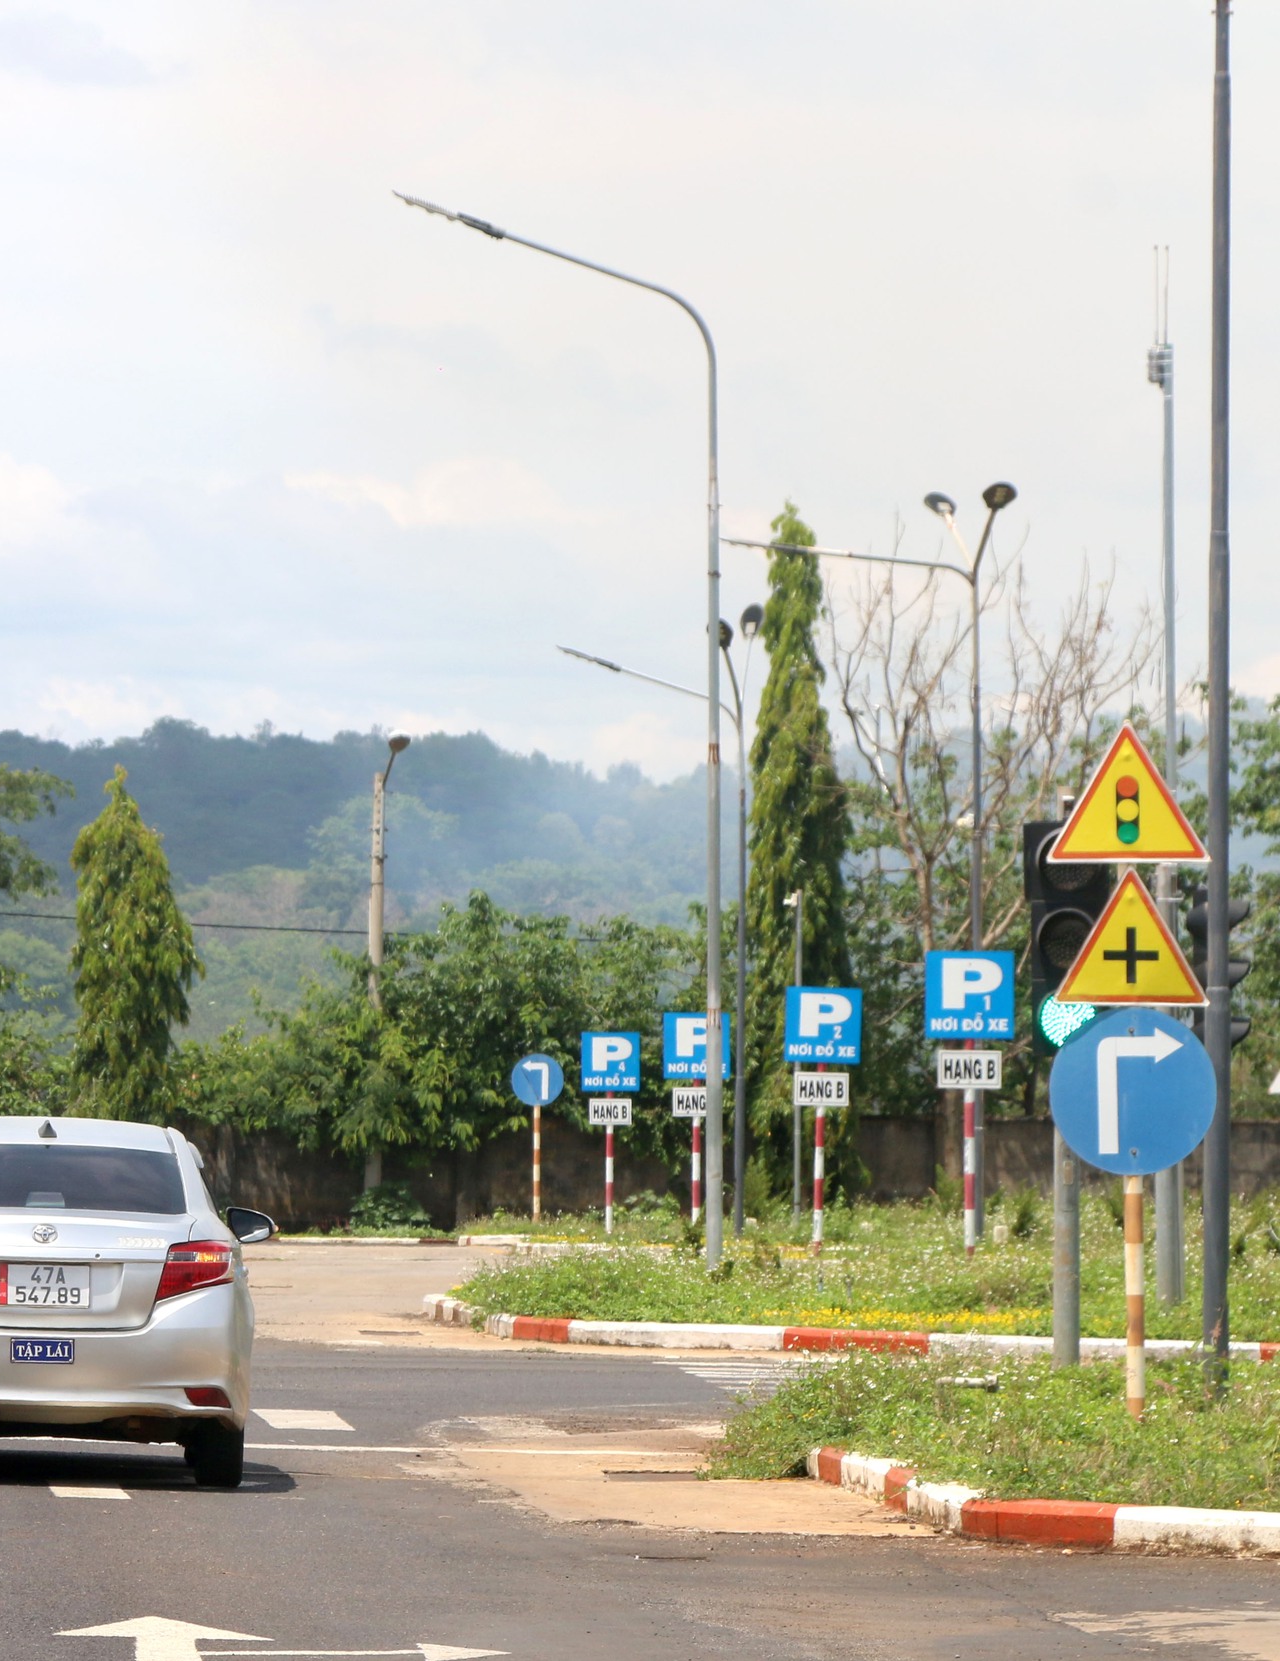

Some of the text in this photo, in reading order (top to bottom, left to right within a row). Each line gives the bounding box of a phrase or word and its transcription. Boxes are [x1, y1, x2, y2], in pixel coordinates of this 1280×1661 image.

[942, 958, 1003, 1010] P
[983, 995, 991, 1011] 1
[799, 992, 852, 1037] P
[931, 1012, 1008, 1031] NƠI ĐỖ XE
[833, 1025, 842, 1039] 2
[592, 1036, 632, 1071] P
[789, 1039, 855, 1057] NƠI ĐỖ XE
[618, 1061, 626, 1072] 4
[668, 1061, 688, 1073] NƠI
[944, 1059, 996, 1084] HẠNG B
[584, 1075, 603, 1086] NƠI
[622, 1077, 637, 1086] XE
[799, 1080, 844, 1103] HẠNG B
[677, 1094, 706, 1114] HẠNG
[593, 1104, 628, 1123] HẠNG B
[31, 1266, 66, 1284] 47A
[15, 1286, 81, 1304] 547.89
[16, 1342, 69, 1360] TẬP LÁI
